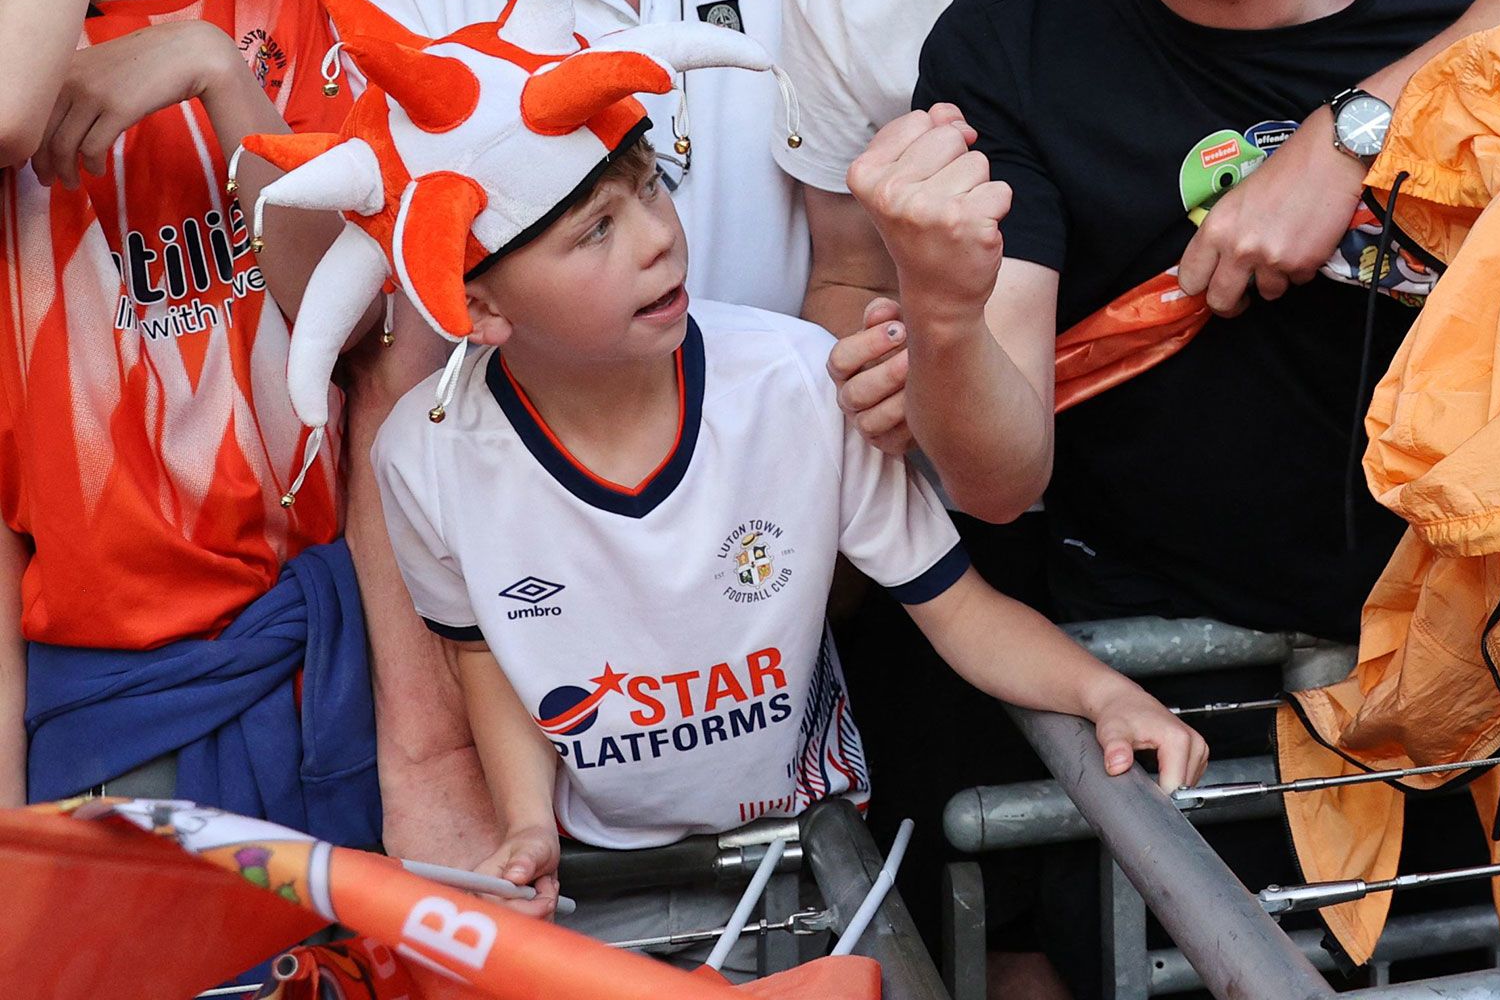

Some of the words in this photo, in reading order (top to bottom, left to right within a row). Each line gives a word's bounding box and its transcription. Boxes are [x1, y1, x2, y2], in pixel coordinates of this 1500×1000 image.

[239, 28, 267, 51] LUTON
[1258, 132, 1292, 145] offende
[142, 298, 218, 341] with
[717, 524, 746, 559] LUTON
[749, 519, 784, 539] TOWN
[723, 586, 772, 603] FOOTBALL
[771, 567, 793, 593] CLUB
[507, 604, 562, 620] umbro
[627, 647, 787, 726] STAR
[551, 693, 792, 769] PLATFORMS
